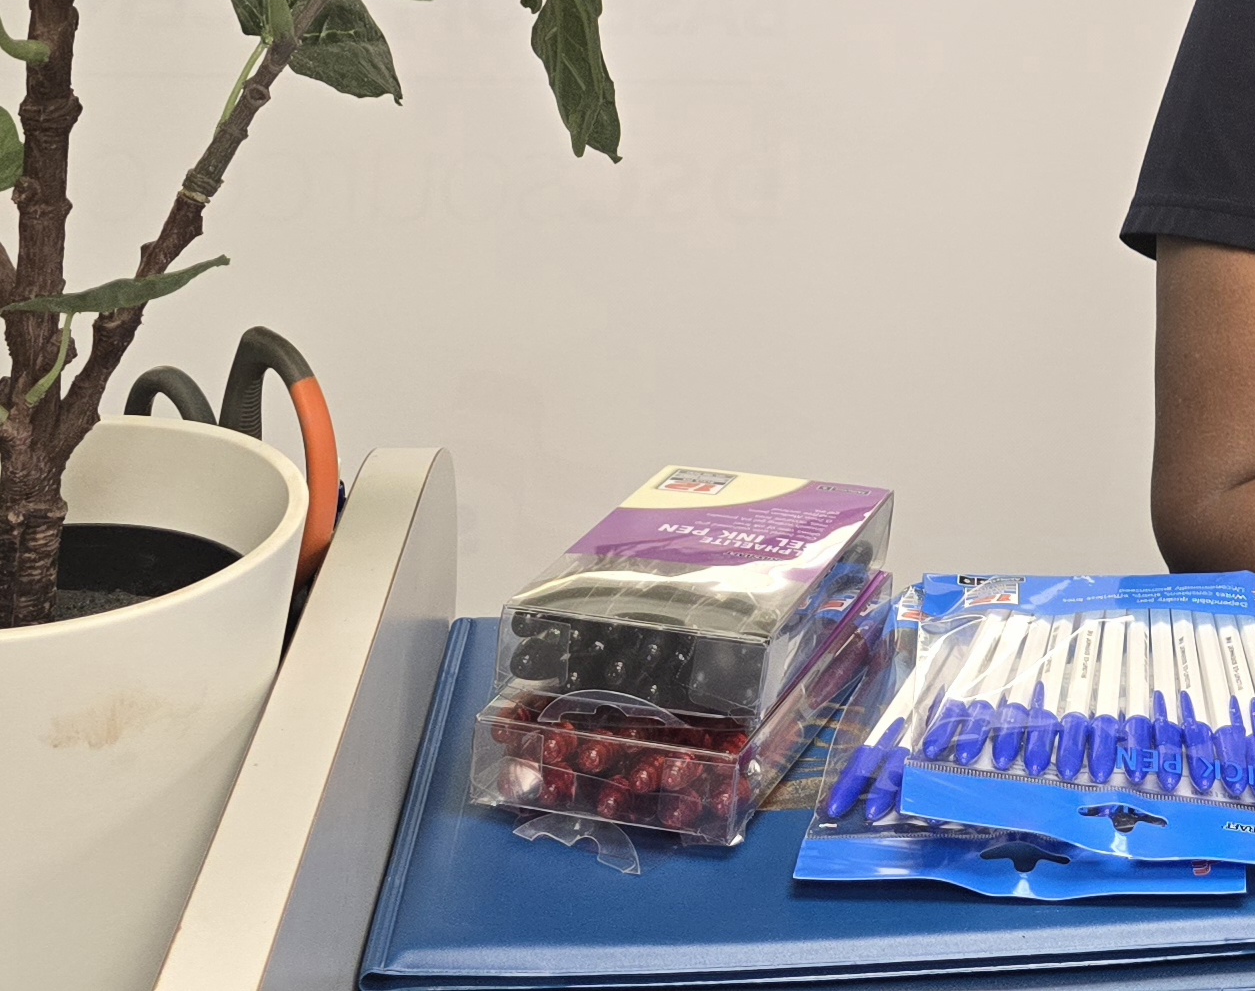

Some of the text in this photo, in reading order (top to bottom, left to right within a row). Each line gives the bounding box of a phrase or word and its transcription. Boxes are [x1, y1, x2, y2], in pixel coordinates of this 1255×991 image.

[656, 522, 712, 538] PEN
[720, 529, 765, 544] INK
[698, 536, 805, 558] LPHAELITE
[1191, 597, 1249, 609] Dependable
[1115, 745, 1183, 775] PEN
